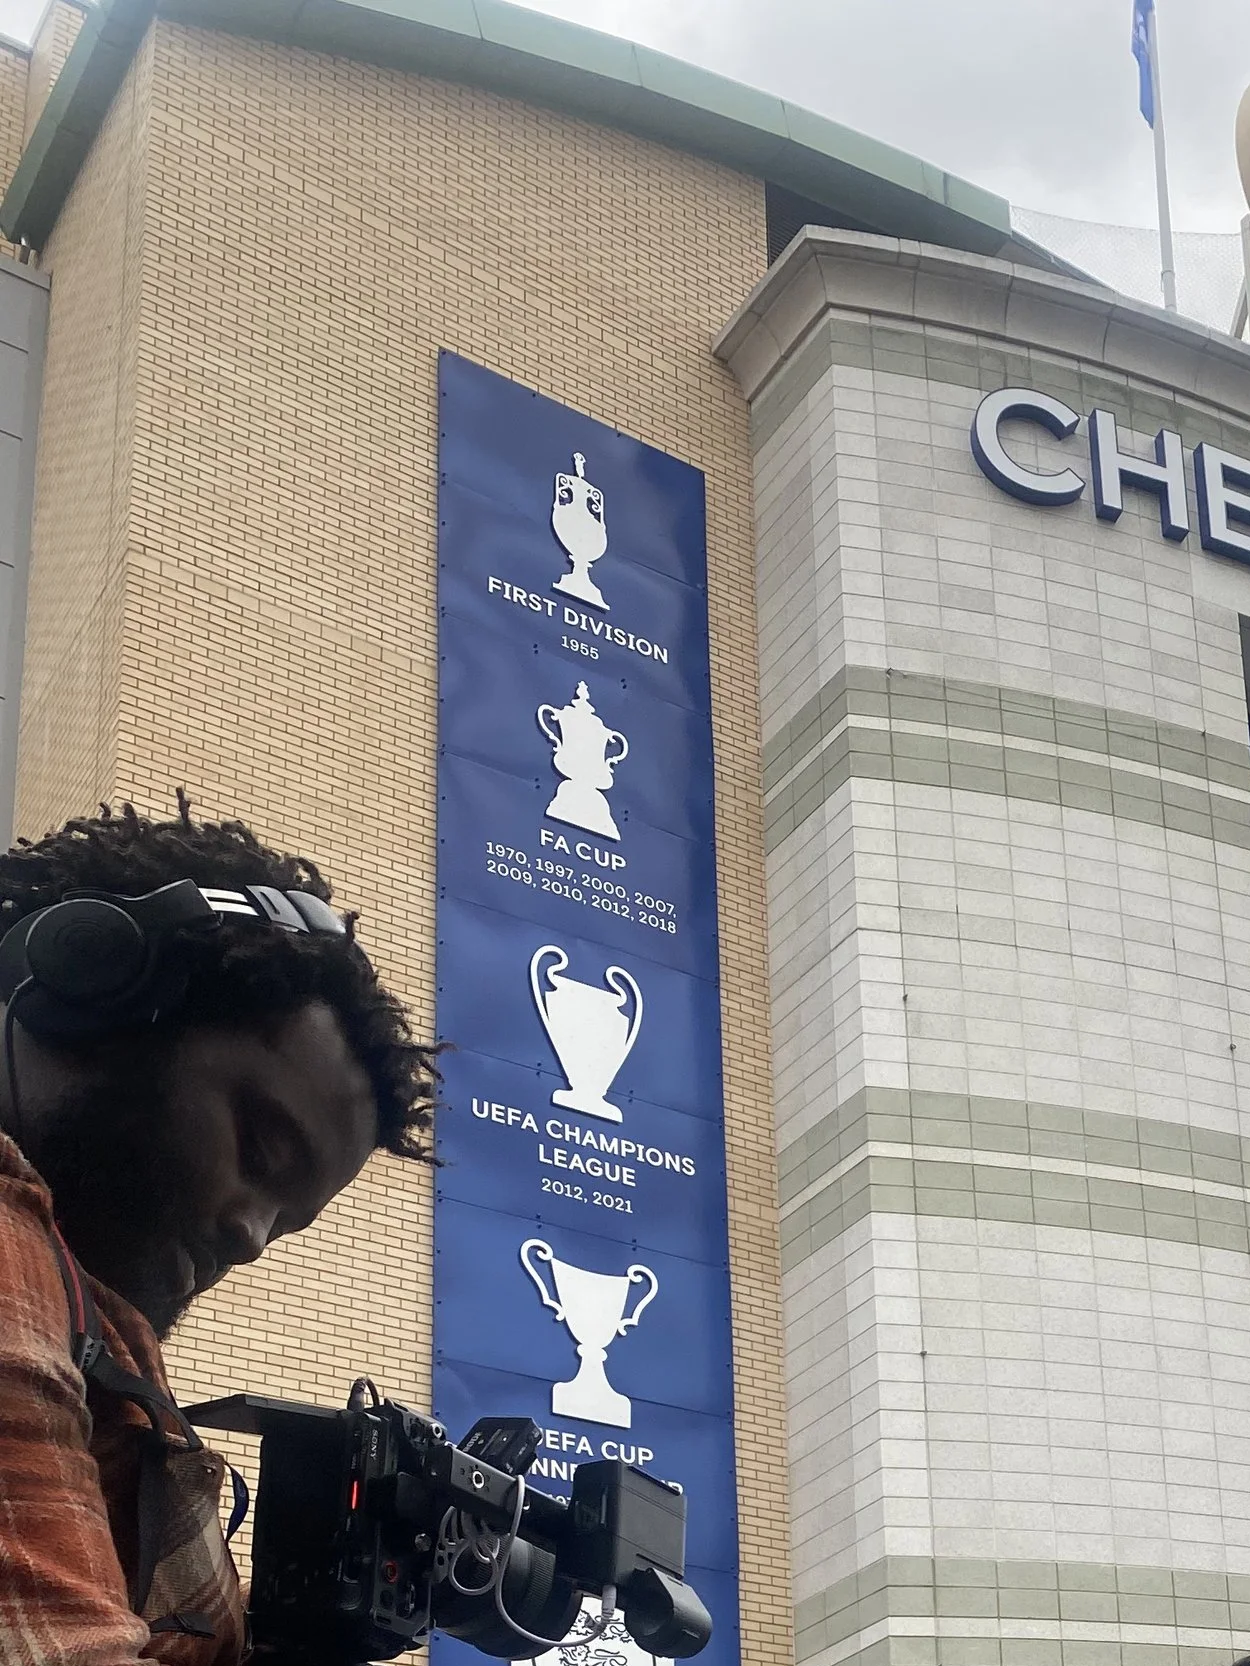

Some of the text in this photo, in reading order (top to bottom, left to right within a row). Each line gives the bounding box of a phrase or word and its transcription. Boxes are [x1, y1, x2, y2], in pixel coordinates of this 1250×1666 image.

[487, 575, 669, 665] FIRST DIVISION
[561, 635, 600, 661] 1955
[539, 828, 627, 871] FA CUP
[486, 841, 678, 919] 1970, 1997, 2000, 2007,
[486, 859, 677, 935] 2009, 2010, 2012, 2018
[471, 1097, 697, 1177] UEFA CHAMPIONS
[538, 1143, 637, 1188] LEAGUE
[541, 1177, 634, 1214] 2012, 2021
[600, 1440, 654, 1466] CUP
